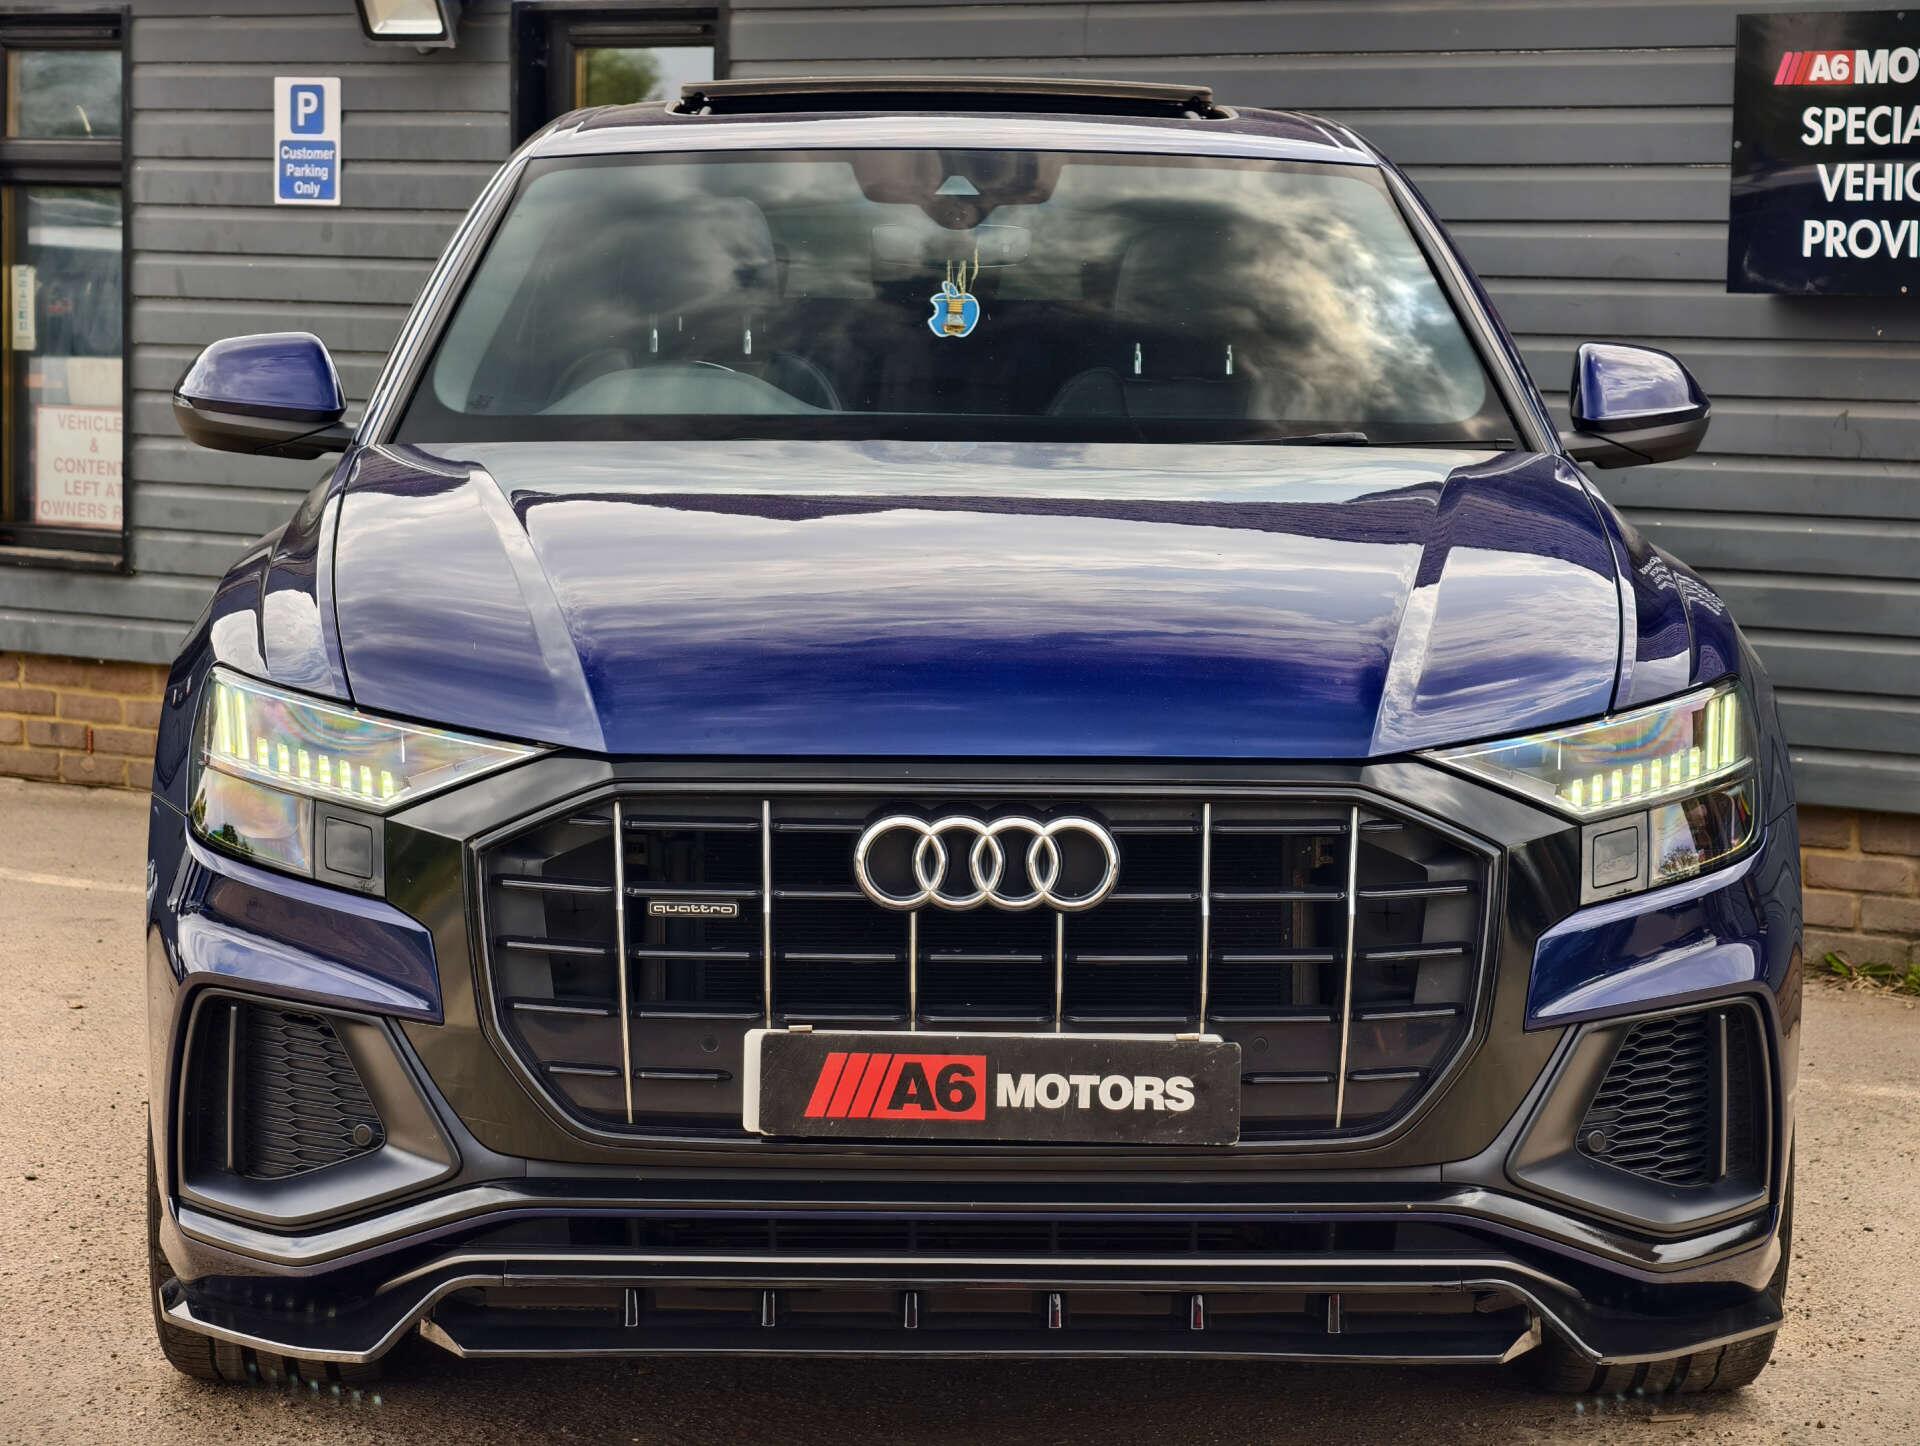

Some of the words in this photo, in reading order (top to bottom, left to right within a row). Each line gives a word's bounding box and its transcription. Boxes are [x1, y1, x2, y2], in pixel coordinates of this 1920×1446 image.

[1809, 54, 1850, 82] A6
[1854, 47, 1920, 84] MO
[297, 91, 318, 127] P
[281, 146, 335, 159] Customer
[286, 164, 328, 180] Parking
[1816, 162, 1920, 203] VEHIC
[294, 181, 320, 198] Only
[1802, 219, 1920, 259] PROVI
[57, 412, 122, 434] VEHICLE
[89, 437, 99, 453] &
[64, 479, 100, 498] LEFT
[40, 499, 107, 520] OWNERS
[653, 904, 733, 914] quattro
[887, 1062, 976, 1113] A6
[996, 1073, 1195, 1112] MOTORS
